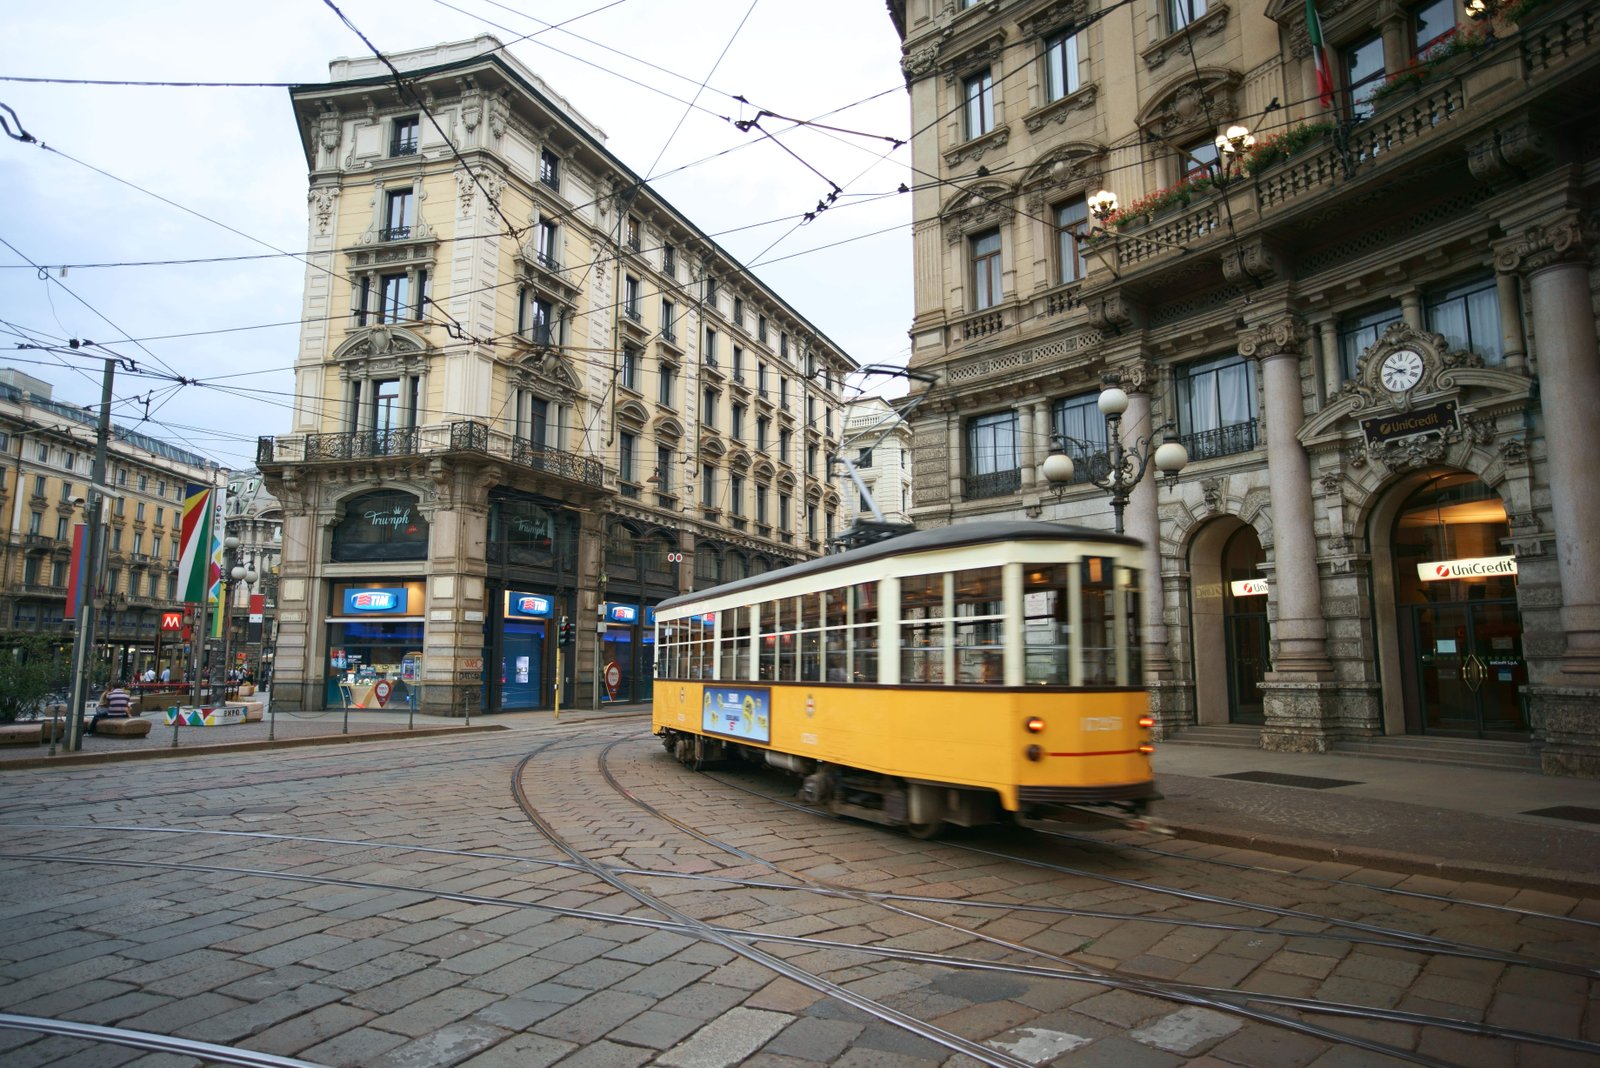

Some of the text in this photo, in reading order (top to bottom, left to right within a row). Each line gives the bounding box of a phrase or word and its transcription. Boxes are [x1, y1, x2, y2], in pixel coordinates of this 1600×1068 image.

[1391, 413, 1438, 431] UniCredit
[364, 508, 411, 530] Triumph
[1451, 561, 1514, 576] UniCredit
[371, 595, 390, 607] TIM
[534, 601, 547, 611] TIM
[624, 610, 635, 620] TIM
[163, 616, 180, 628] M
[223, 708, 240, 717] EXPO
